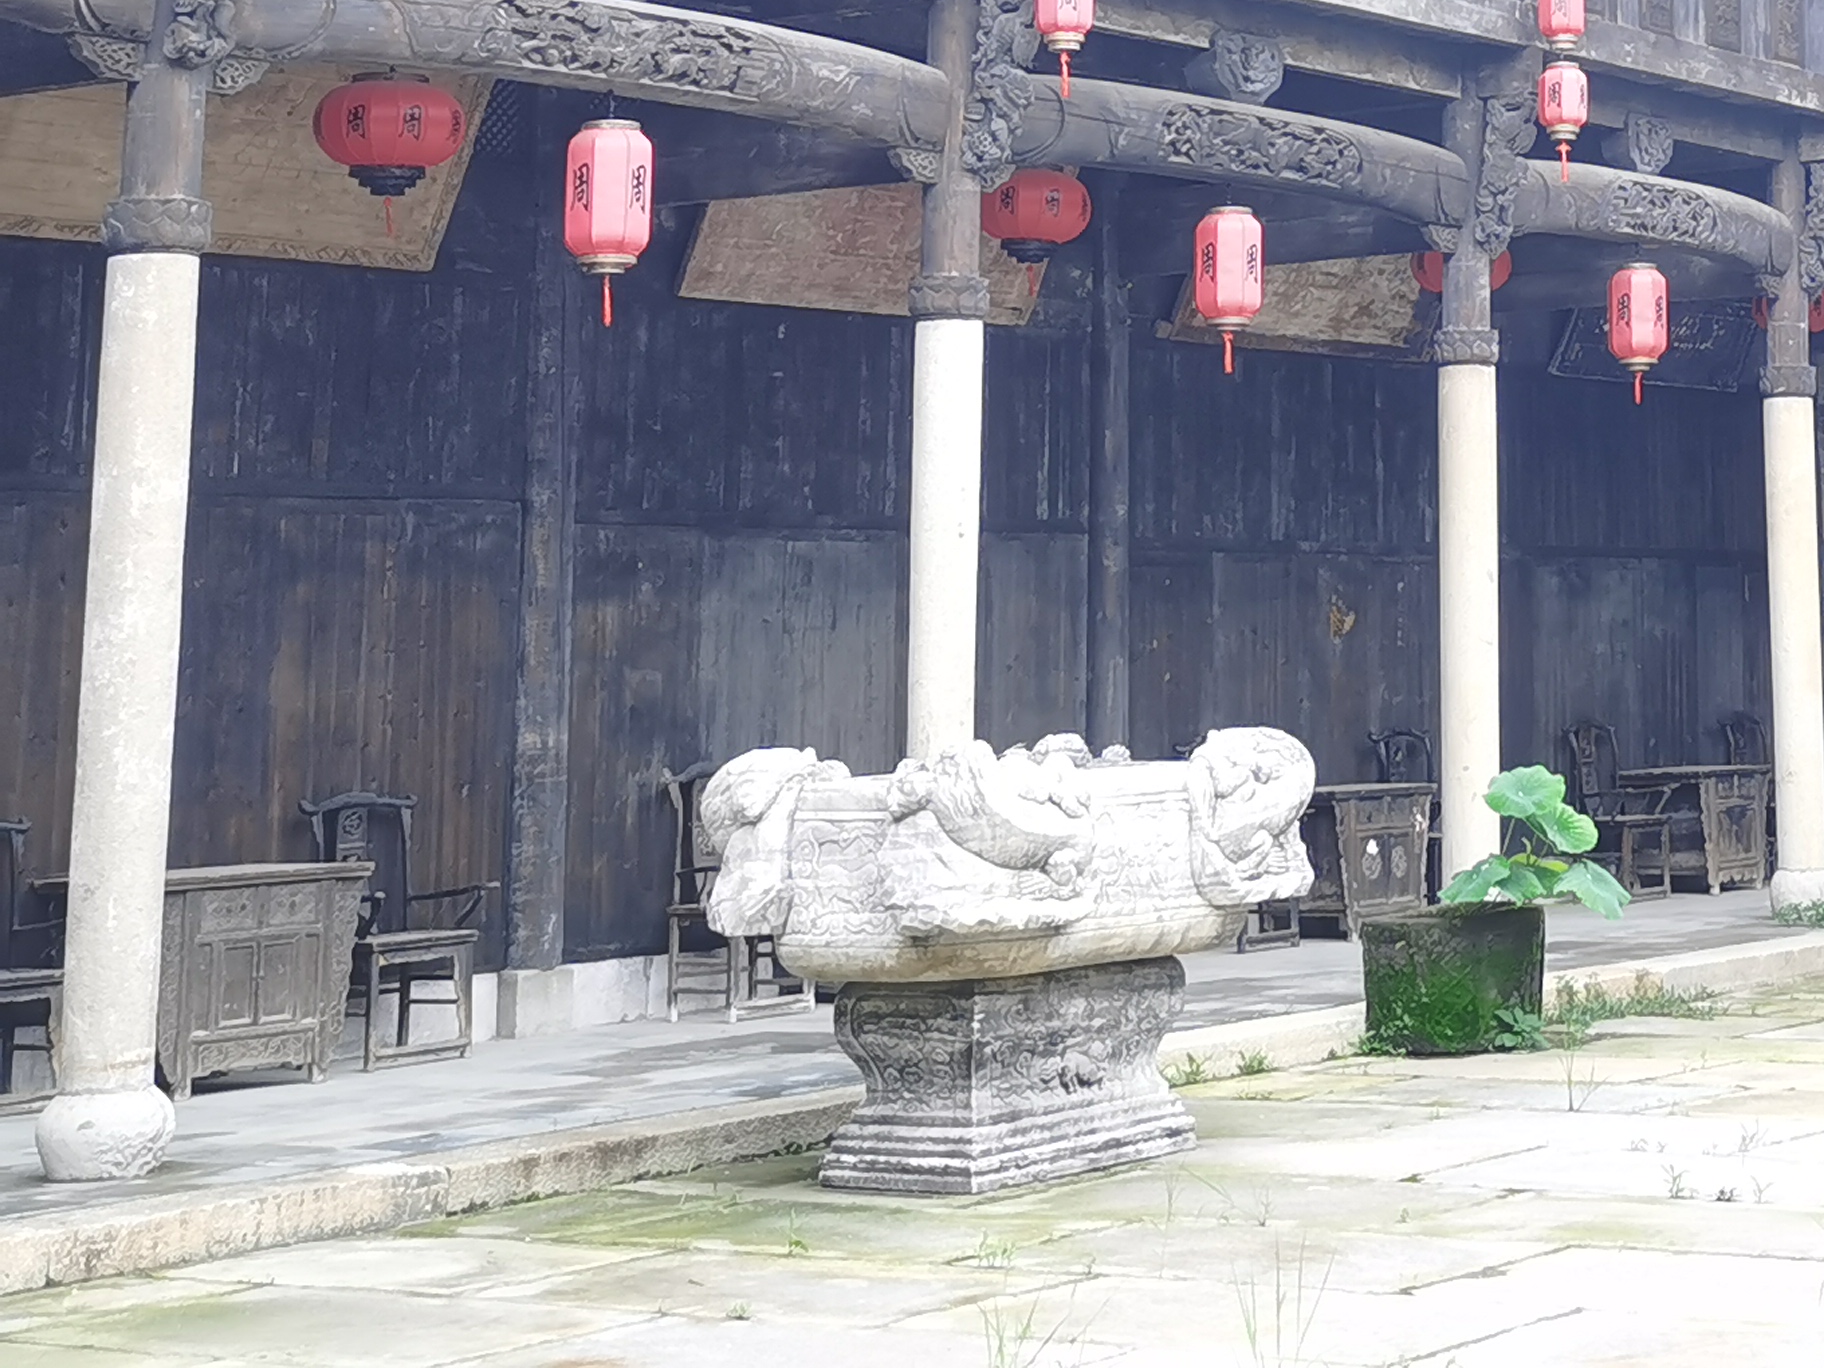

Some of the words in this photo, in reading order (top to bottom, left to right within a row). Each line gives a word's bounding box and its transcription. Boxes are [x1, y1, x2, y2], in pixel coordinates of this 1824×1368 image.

[346, 104, 365, 139] 周
[398, 104, 422, 141] 周
[570, 162, 590, 212] 周
[629, 164, 647, 215] 周
[998, 185, 1015, 215] 周
[1043, 187, 1060, 218] 周
[1199, 241, 1215, 283] 周
[1245, 243, 1258, 284] 周
[1616, 292, 1631, 328] 周
